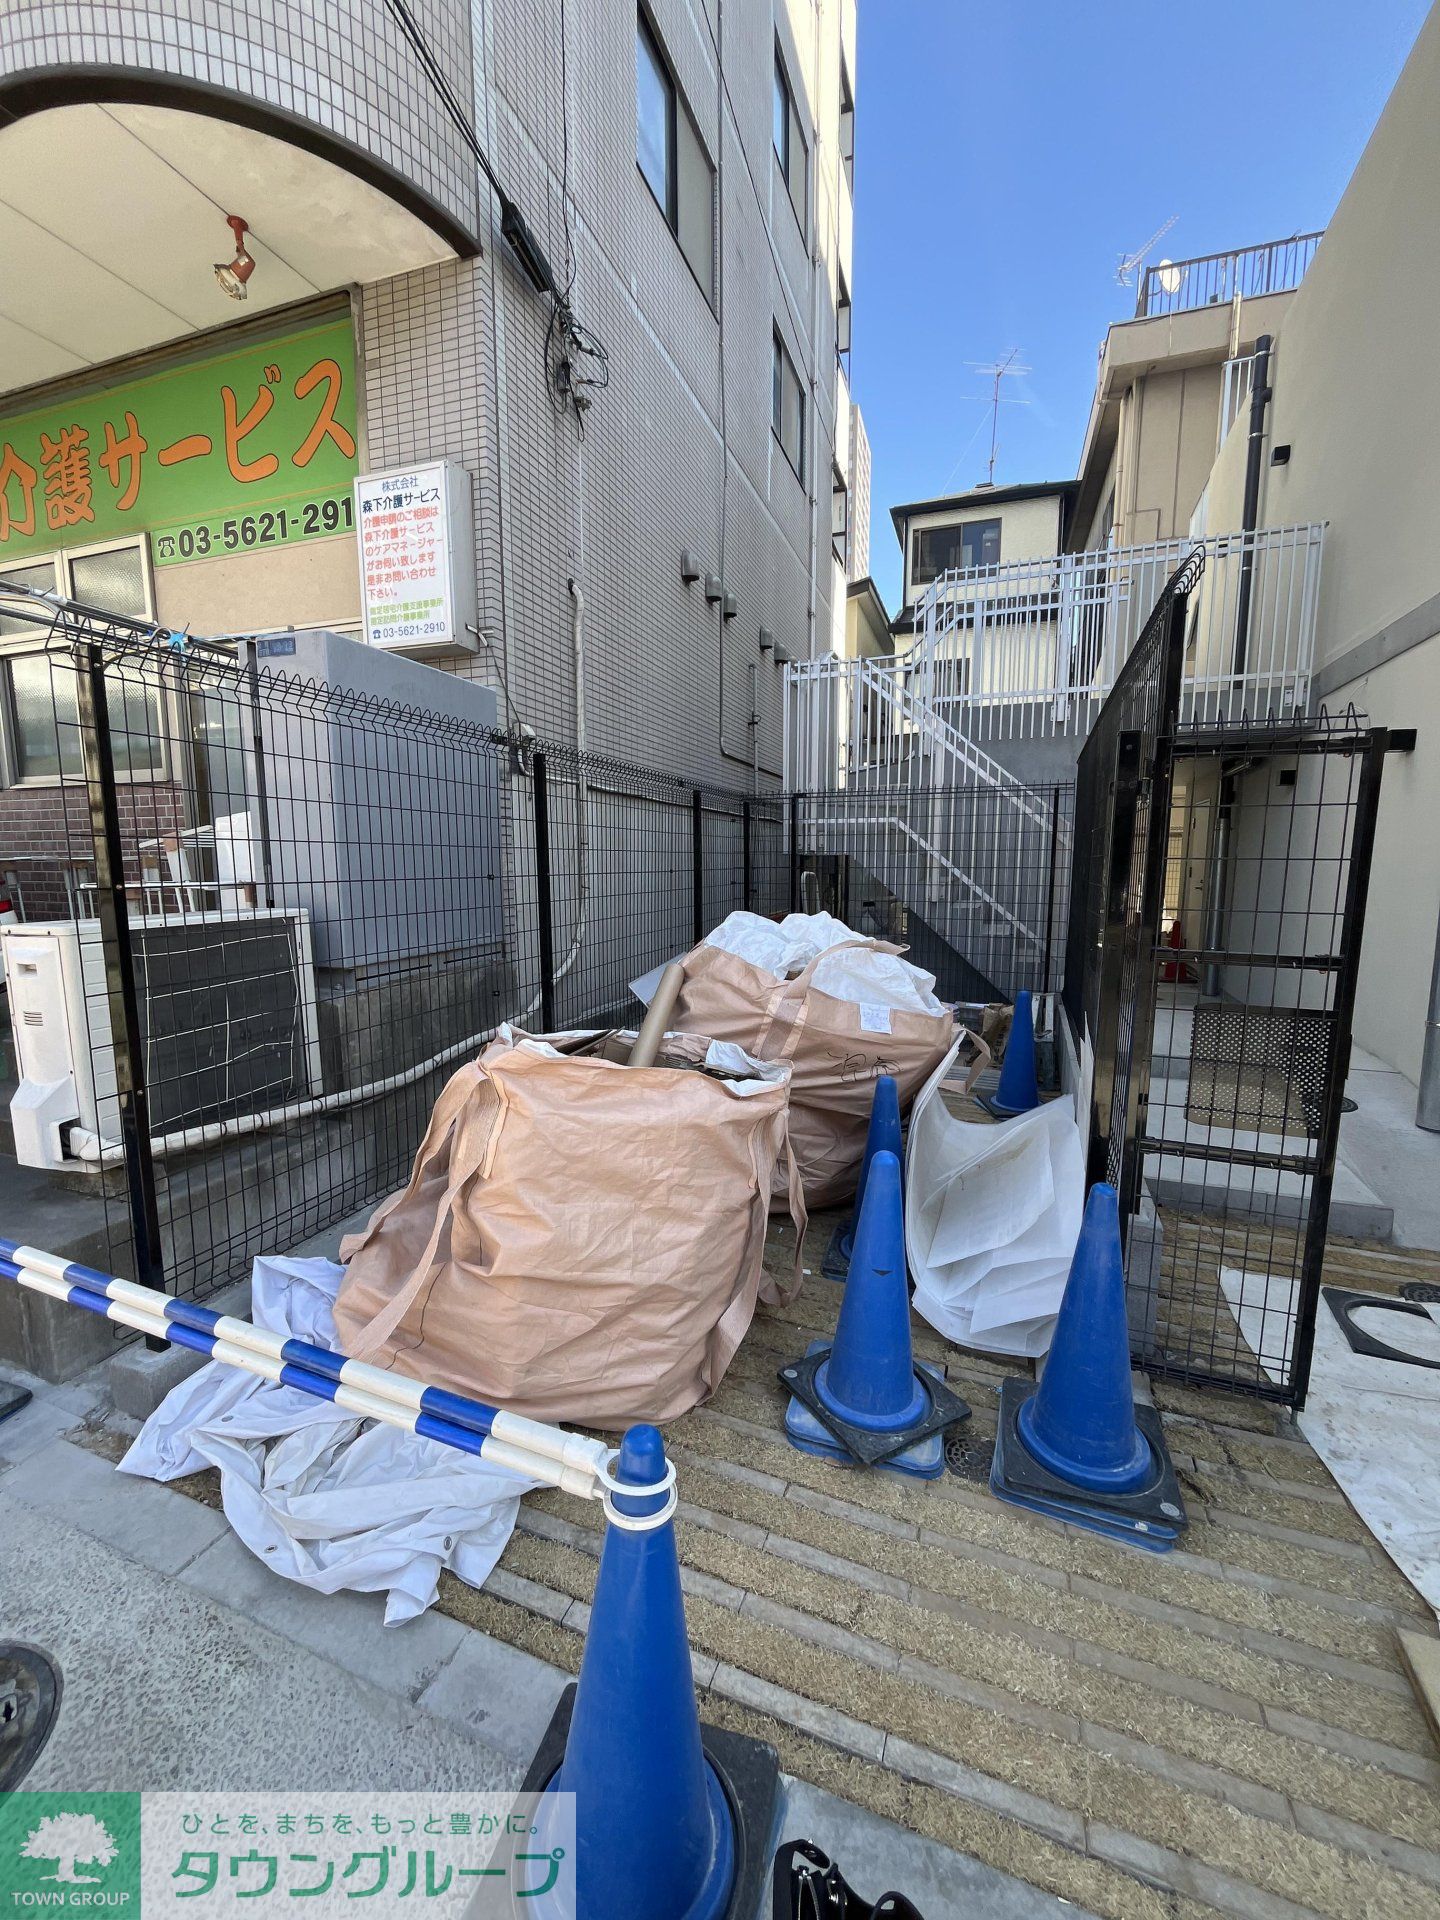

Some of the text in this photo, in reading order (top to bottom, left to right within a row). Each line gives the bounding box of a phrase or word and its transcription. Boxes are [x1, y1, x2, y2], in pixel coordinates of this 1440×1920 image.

[0, 358, 357, 542] 介護サービス
[382, 475, 419, 492] 株式会社
[362, 488, 441, 513] 森下介護サービス
[364, 506, 439, 528] 介護申請のご相談は
[364, 521, 435, 542] 森下介護サービス
[365, 536, 443, 556] のケアマネージャー
[366, 551, 435, 572] がお伺い致します
[367, 566, 436, 586] 是非お問い合わせ
[367, 587, 398, 601] 下さい。
[383, 621, 446, 638] 03-5621-2910
